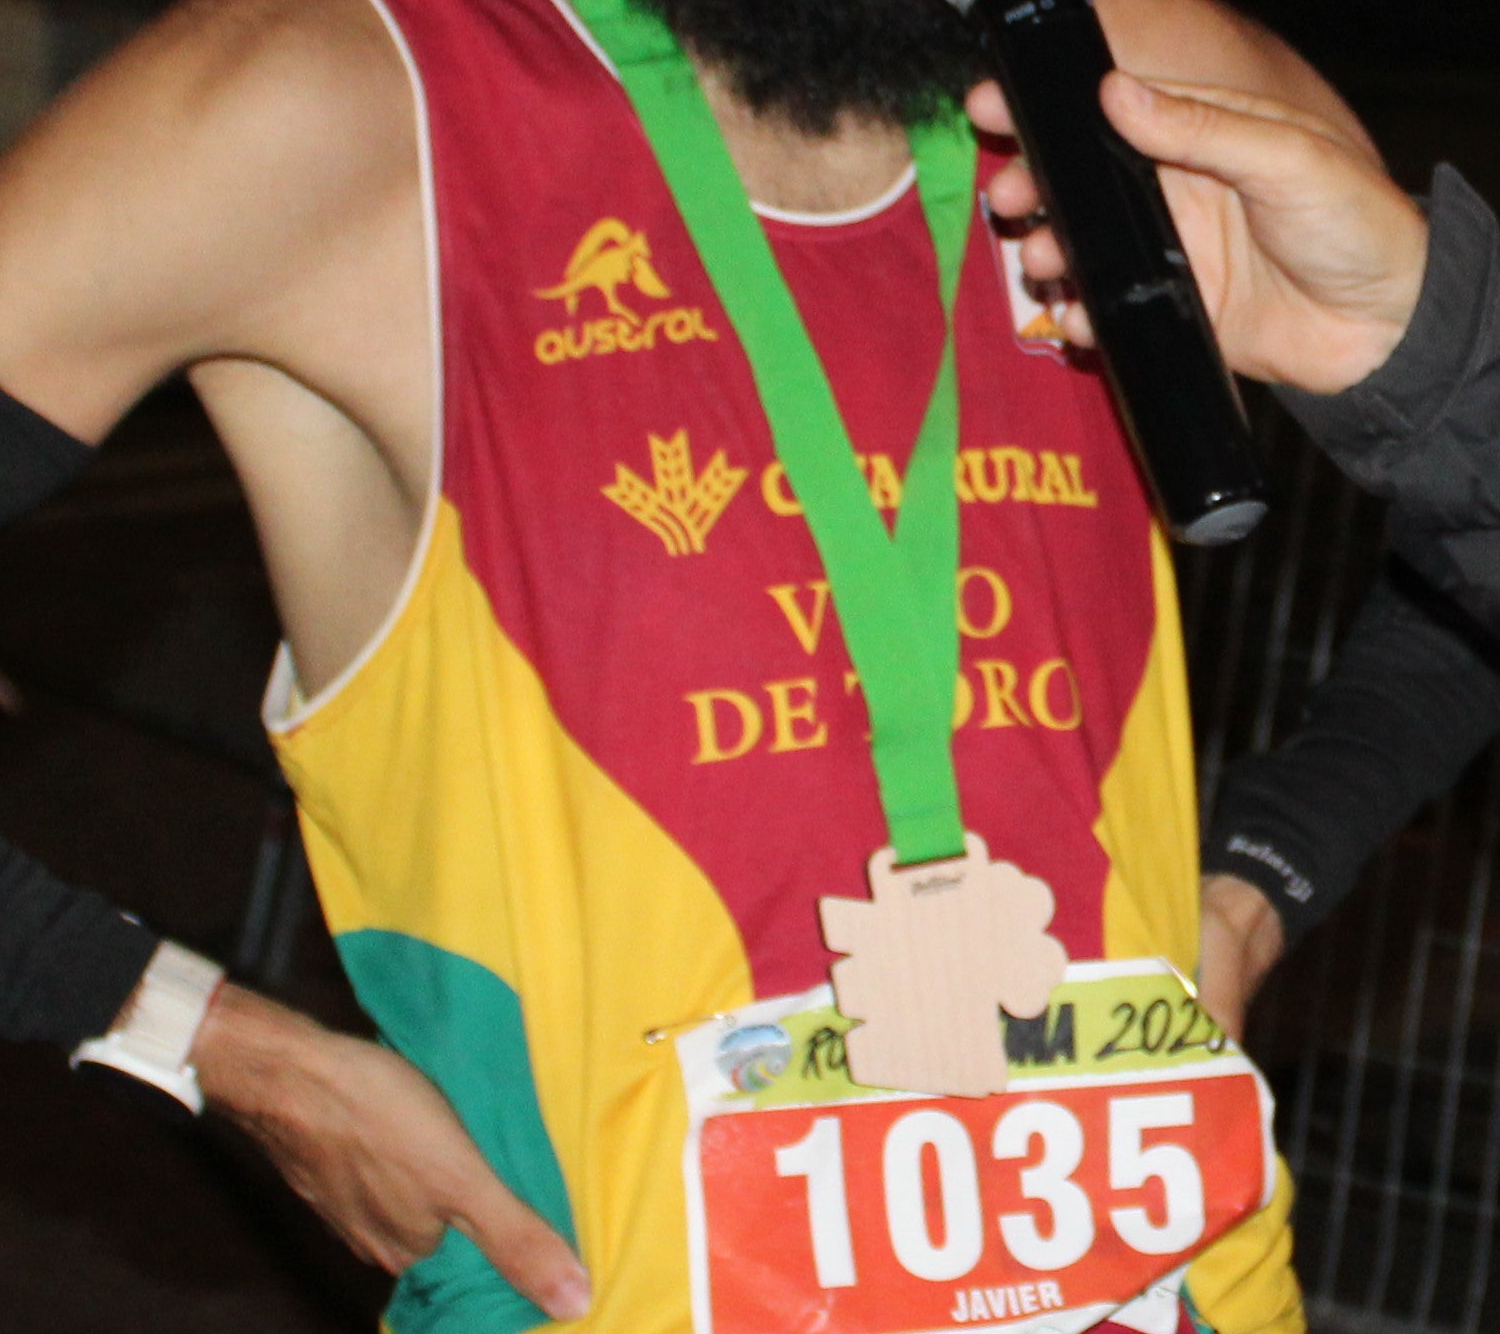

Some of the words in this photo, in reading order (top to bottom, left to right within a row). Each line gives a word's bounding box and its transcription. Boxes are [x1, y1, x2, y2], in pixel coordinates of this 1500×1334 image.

[534, 307, 719, 365] austral
[760, 453, 902, 518] CA
[954, 445, 1098, 508] RURAL
[765, 565, 1013, 656] VO
[683, 676, 830, 766] DE
[773, 1091, 1207, 1290] 1035
[951, 1280, 1065, 1324] JAVIER
